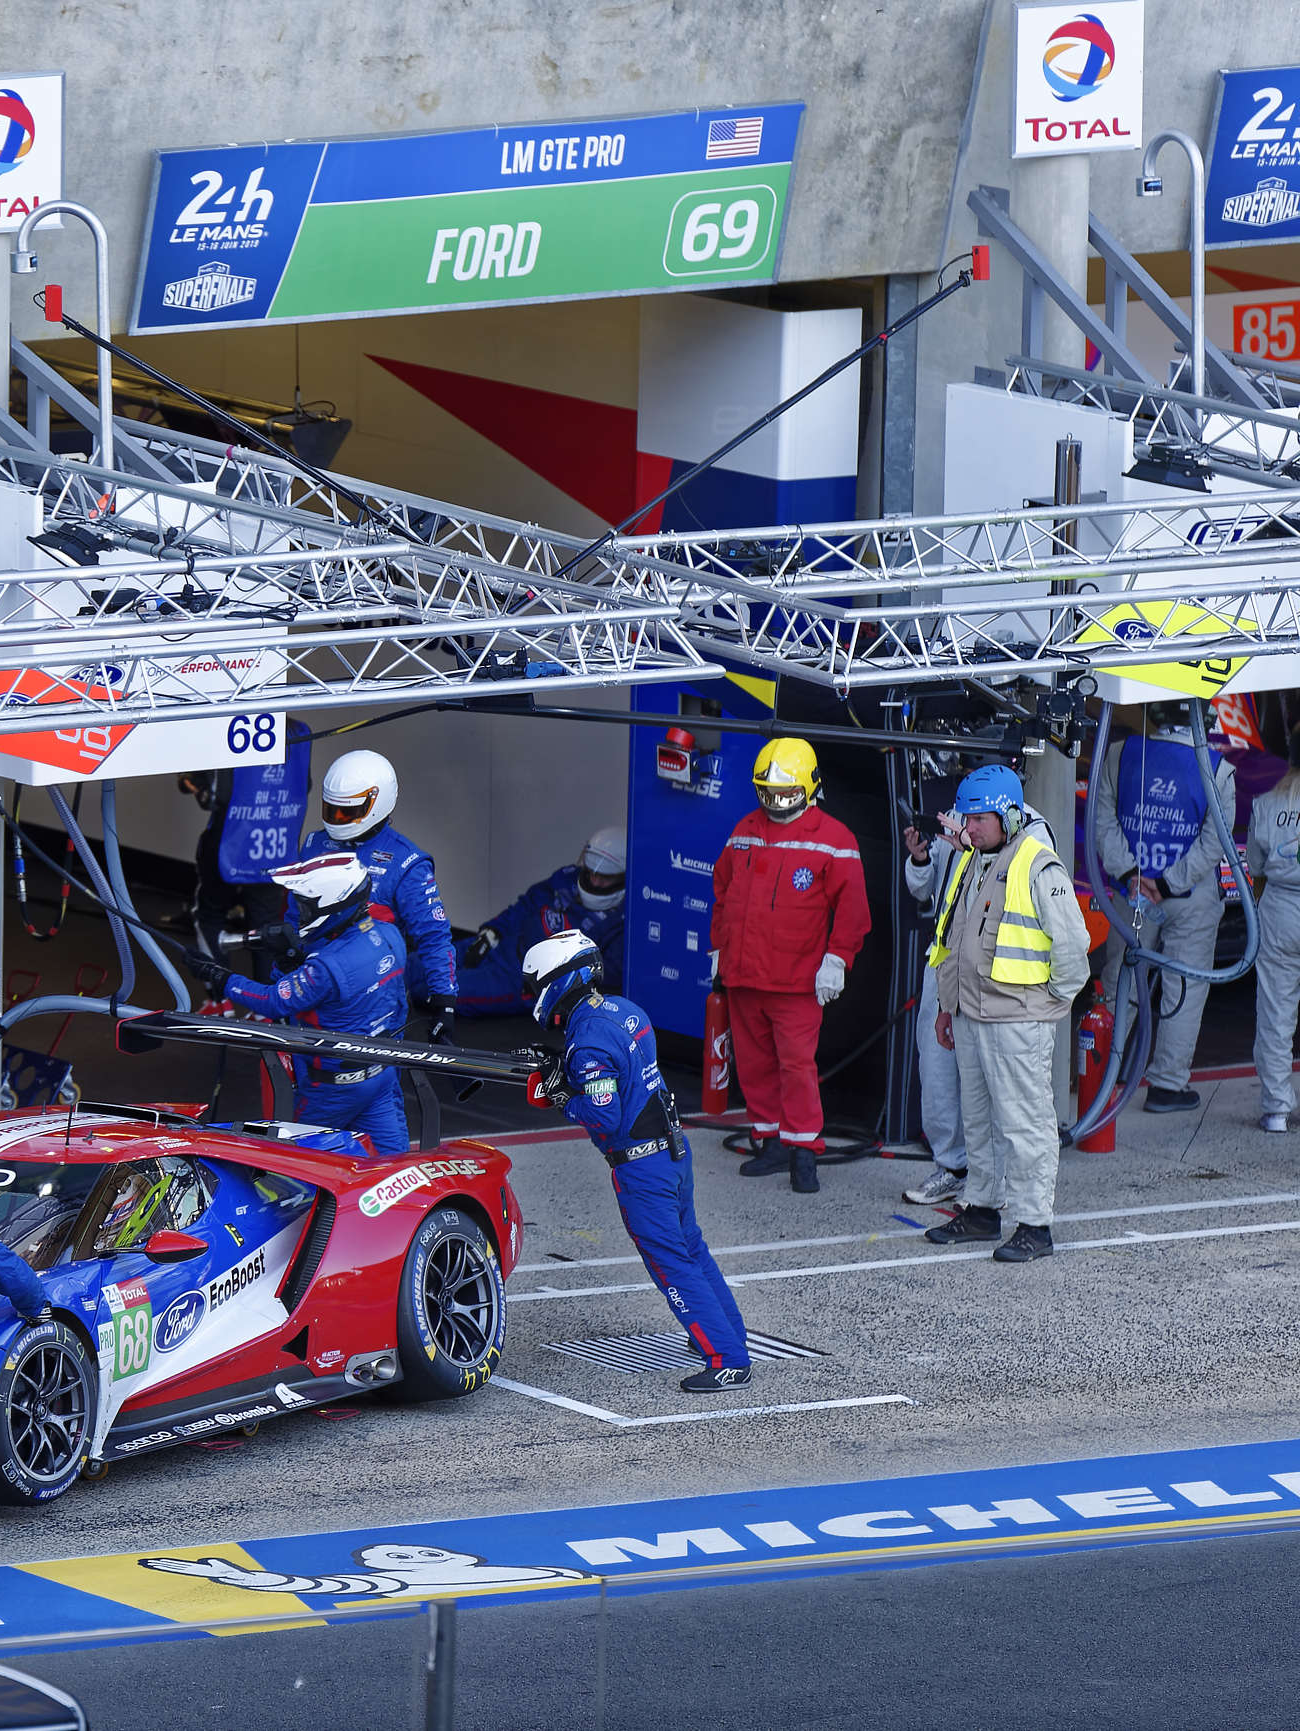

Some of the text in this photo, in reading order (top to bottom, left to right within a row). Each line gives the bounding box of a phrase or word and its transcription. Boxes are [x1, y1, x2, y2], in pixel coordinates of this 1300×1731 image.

[1025, 117, 1131, 142] TOTAL
[1237, 87, 1300, 142] 24
[501, 133, 625, 174] LM GTE PRO
[1230, 143, 1258, 159] LE
[176, 166, 274, 226] 24h
[169, 223, 264, 243] LE MANS
[426, 199, 760, 284] FORD 69
[164, 273, 255, 311] SUPERFINALE
[1241, 305, 1297, 360] 85
[227, 713, 276, 754] 68
[1133, 803, 1185, 822] MARSHAL
[249, 828, 288, 860] 335
[1170, 823, 1199, 836] TRAC
[1135, 842, 1184, 871] 867
[333, 1041, 456, 1066] Powered by
[584, 1081, 615, 1096] PITLANE
[376, 1160, 487, 1201] Castrol EDGE
[121, 1287, 147, 1300] TOTAL
[209, 1247, 266, 1312] EcoBoost
[415, 1252, 426, 1330] MICHELIN
[163, 1299, 198, 1346] Ford
[16, 1325, 54, 1352] MICHELIN
[100, 1328, 114, 1351] PRO
[118, 1310, 149, 1375] 68
[231, 1405, 278, 1422] brembo
[115, 1431, 174, 1451] sparco
